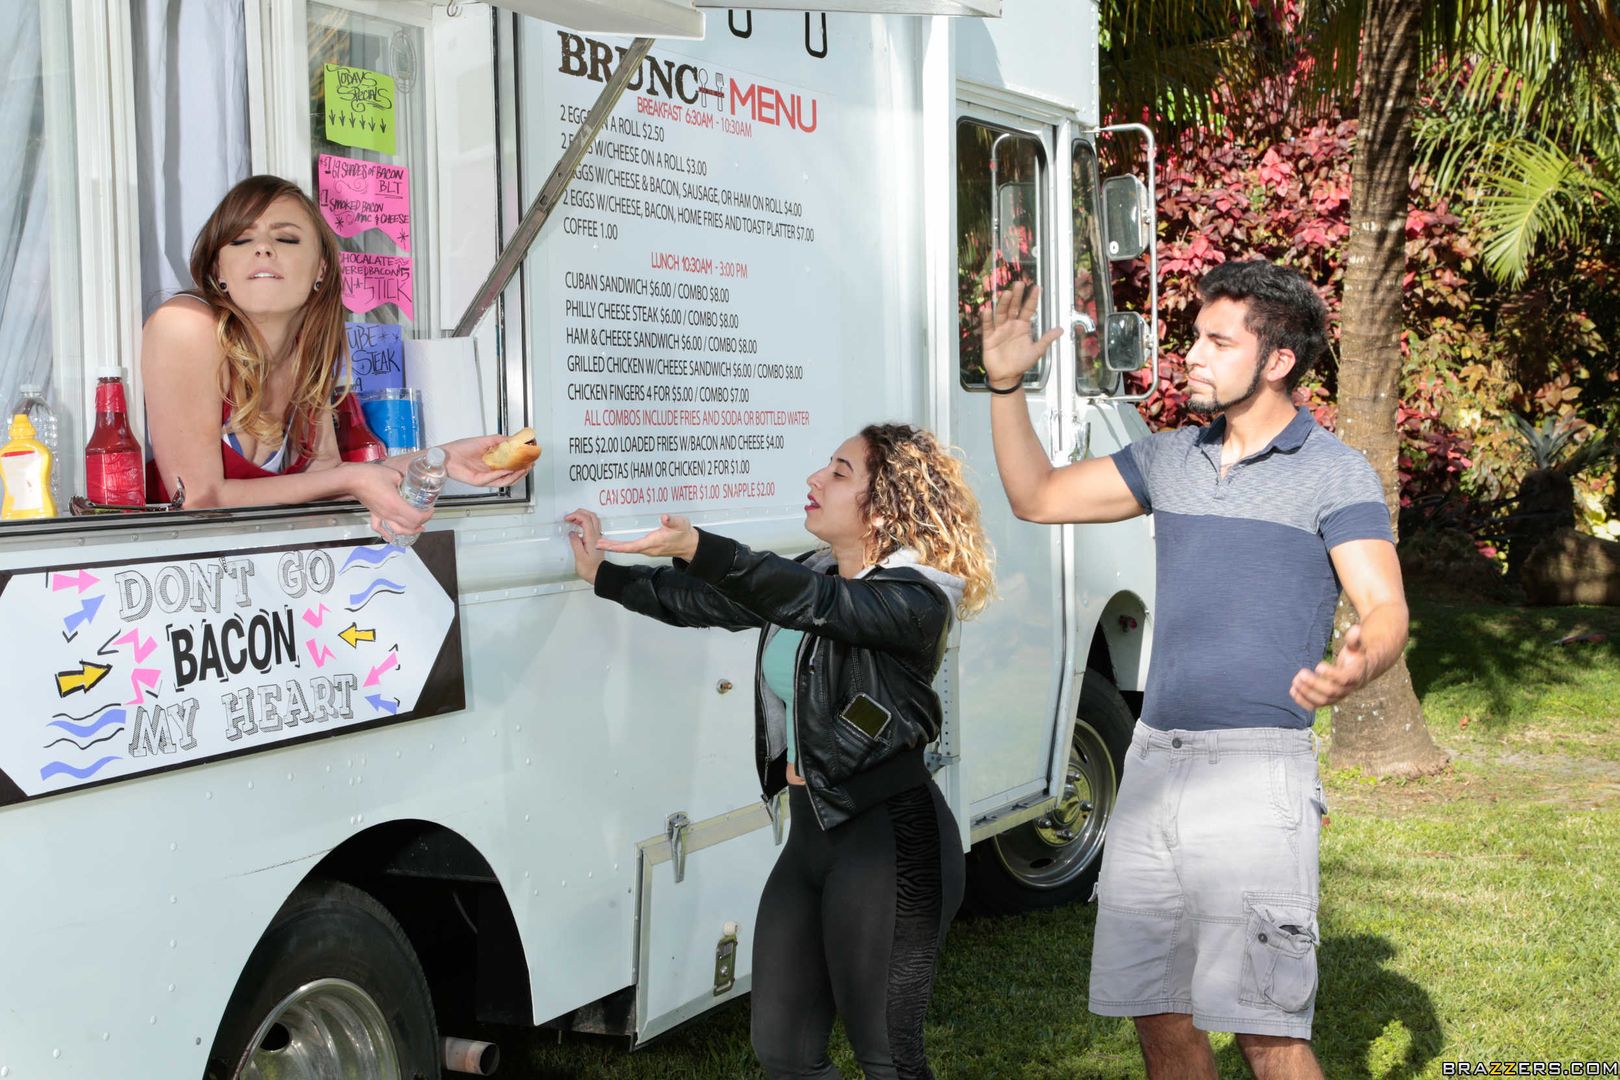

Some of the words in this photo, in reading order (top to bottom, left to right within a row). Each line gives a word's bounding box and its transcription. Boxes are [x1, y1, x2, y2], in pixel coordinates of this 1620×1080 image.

[637, 96, 683, 122] BREAKFAST
[685, 107, 714, 129] 6:30AM
[721, 118, 752, 138] 10:30AM
[730, 77, 817, 133] MENU
[560, 104, 566, 121] 2
[568, 106, 591, 124] EGG
[610, 116, 617, 133] A
[619, 117, 641, 137] ROLL
[643, 122, 665, 142] $2.50
[561, 132, 567, 149] 2
[594, 140, 640, 163] W/CHEESE
[641, 148, 655, 167] ON
[656, 152, 663, 168] A
[664, 153, 685, 173] ROLL
[686, 157, 707, 176] $3.00
[376, 166, 403, 180] BACON
[379, 180, 402, 194] BLT
[595, 166, 640, 190] W/CHEESE
[642, 175, 648, 191] &
[650, 176, 681, 199] BACON,
[682, 182, 720, 206] SAUSAGE,
[721, 189, 733, 206] OR
[734, 191, 751, 208] HAM
[752, 195, 764, 211] ON
[765, 197, 783, 214] ROLL
[784, 200, 802, 217] $4.00
[329, 198, 360, 212] SMOKED
[361, 201, 384, 212] BACON
[380, 213, 409, 224] CHEESE
[562, 188, 568, 205] 2
[570, 189, 595, 209] EGGS
[596, 193, 643, 219] W/CHEESE,
[645, 201, 677, 224] BACON,
[678, 207, 702, 226] HOME
[703, 211, 723, 229] FRIES
[725, 215, 740, 231] AND
[742, 217, 765, 235] TOAST
[767, 221, 796, 240] PLATTER
[797, 225, 815, 242] $7.00
[563, 217, 598, 238] COFFEE
[600, 222, 618, 240] 1.00
[651, 252, 679, 271] LUNCH
[682, 256, 712, 275] 10:30AM
[720, 261, 735, 277] 3:00
[736, 262, 748, 279] PM
[565, 271, 598, 291] CUBAN
[599, 275, 647, 296] SANDWICH
[649, 279, 671, 298] $6.00
[678, 283, 708, 301] COMBO
[710, 286, 729, 303] $8.00
[566, 299, 596, 318] PHILLY
[598, 302, 630, 321] CHEESE
[632, 305, 659, 323] STEAK
[660, 306, 682, 325] $6.00
[688, 310, 717, 327] COMBO
[719, 312, 738, 330] $8.00
[345, 324, 379, 349] UBE
[566, 327, 589, 345] HAM
[591, 328, 597, 346] &
[599, 329, 632, 347] CHEESE
[633, 331, 679, 350] SANDWICH
[681, 334, 702, 351] $6.00
[708, 336, 737, 353] COMBO
[738, 339, 758, 354] $8.00
[352, 347, 400, 375] STEAK
[567, 355, 605, 373] GRILLED
[606, 356, 644, 374] CHICKEN
[645, 358, 688, 376] W/CHEESE
[689, 360, 731, 377] SANDWICH
[733, 362, 752, 378] $6.00
[757, 363, 784, 379] COMBO
[785, 365, 803, 380] $8.00
[567, 383, 608, 401] CHICKEN
[609, 384, 645, 401] FINGERS
[646, 385, 652, 401] 4
[653, 385, 671, 402] FOR
[672, 385, 693, 403] $5.00
[700, 386, 729, 402] COMBO
[730, 387, 750, 403] $7.00
[584, 409, 601, 426] ALL
[602, 409, 641, 426] COMBOS
[642, 409, 678, 426] INCLUDE
[680, 410, 700, 426] FRIES
[703, 410, 719, 426] AND
[721, 410, 743, 426] SODA
[743, 410, 755, 426] OR
[755, 410, 786, 426] BOTTLED
[787, 411, 810, 426] WATER
[569, 436, 594, 454] FRIES
[595, 435, 619, 455] $2.00
[620, 436, 655, 453] LOADED
[656, 436, 678, 452] FRIES
[679, 435, 719, 452] W/BACON
[720, 435, 737, 451] AND
[738, 435, 765, 450] CHEESE
[766, 434, 785, 451] $4.00
[569, 462, 629, 482] CROQUESTAS
[630, 461, 654, 480] (HAM
[655, 461, 667, 477] OR
[668, 460, 706, 477] CHICKEN)
[707, 460, 712, 476] 2
[714, 459, 729, 475] FOR
[731, 458, 750, 476] $1.00
[599, 489, 619, 506] CAN
[620, 487, 645, 505] SODA
[646, 486, 668, 504] $1.00
[670, 485, 698, 501] WATER
[699, 483, 720, 500] $1.00
[723, 482, 755, 499] SNAPPLE
[756, 481, 775, 497] $2.00
[114, 556, 255, 622] DON'T
[278, 549, 335, 599] GO
[170, 607, 298, 688] BACON
[128, 698, 199, 758] MY
[221, 673, 358, 741] HEART
